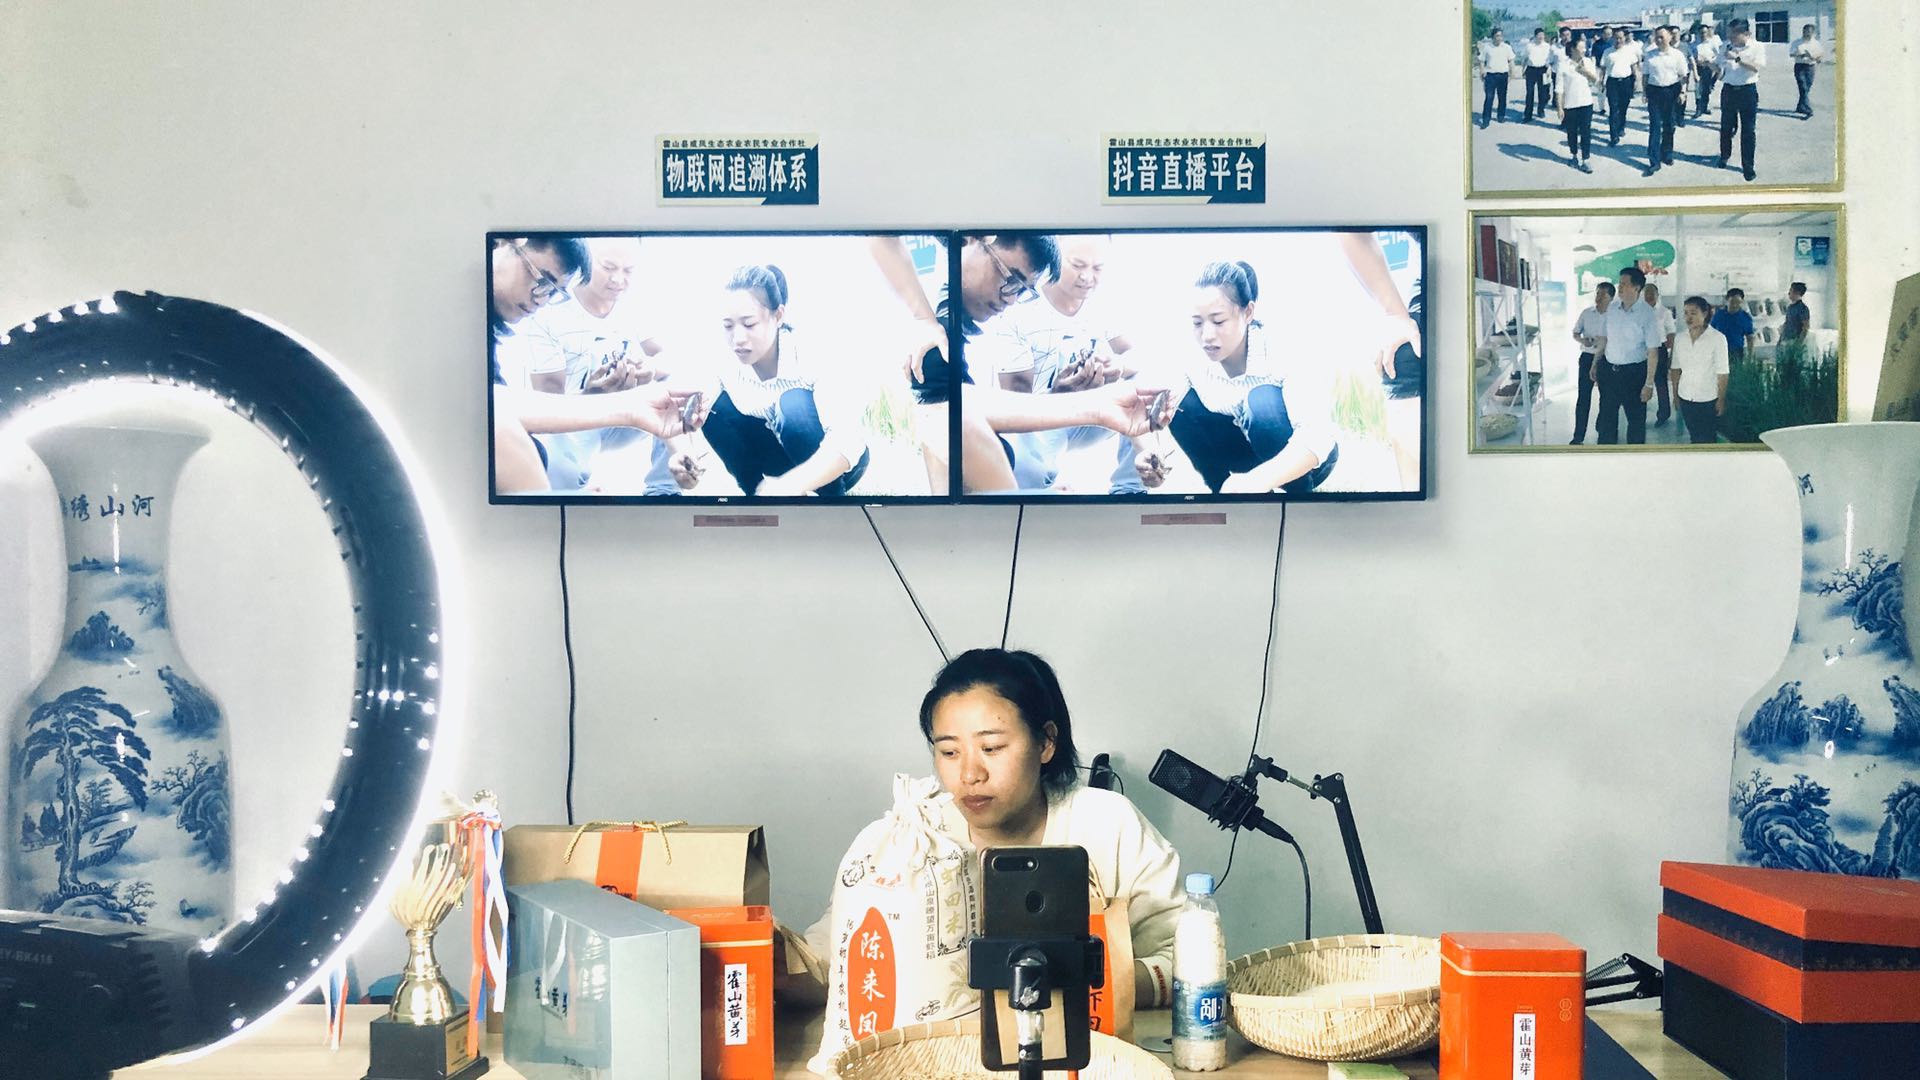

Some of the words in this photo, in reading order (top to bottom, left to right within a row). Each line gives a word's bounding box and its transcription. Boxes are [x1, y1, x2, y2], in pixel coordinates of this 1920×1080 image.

[666, 152, 807, 193] 物联网追溯体系
[1113, 151, 1255, 192] 抖音直播平台
[887, 912, 901, 921] TM
[727, 969, 744, 1038] 霍山黄芽
[859, 929, 886, 1037] 陈来凤
[1519, 1016, 1533, 1076] 霍山黄芽
